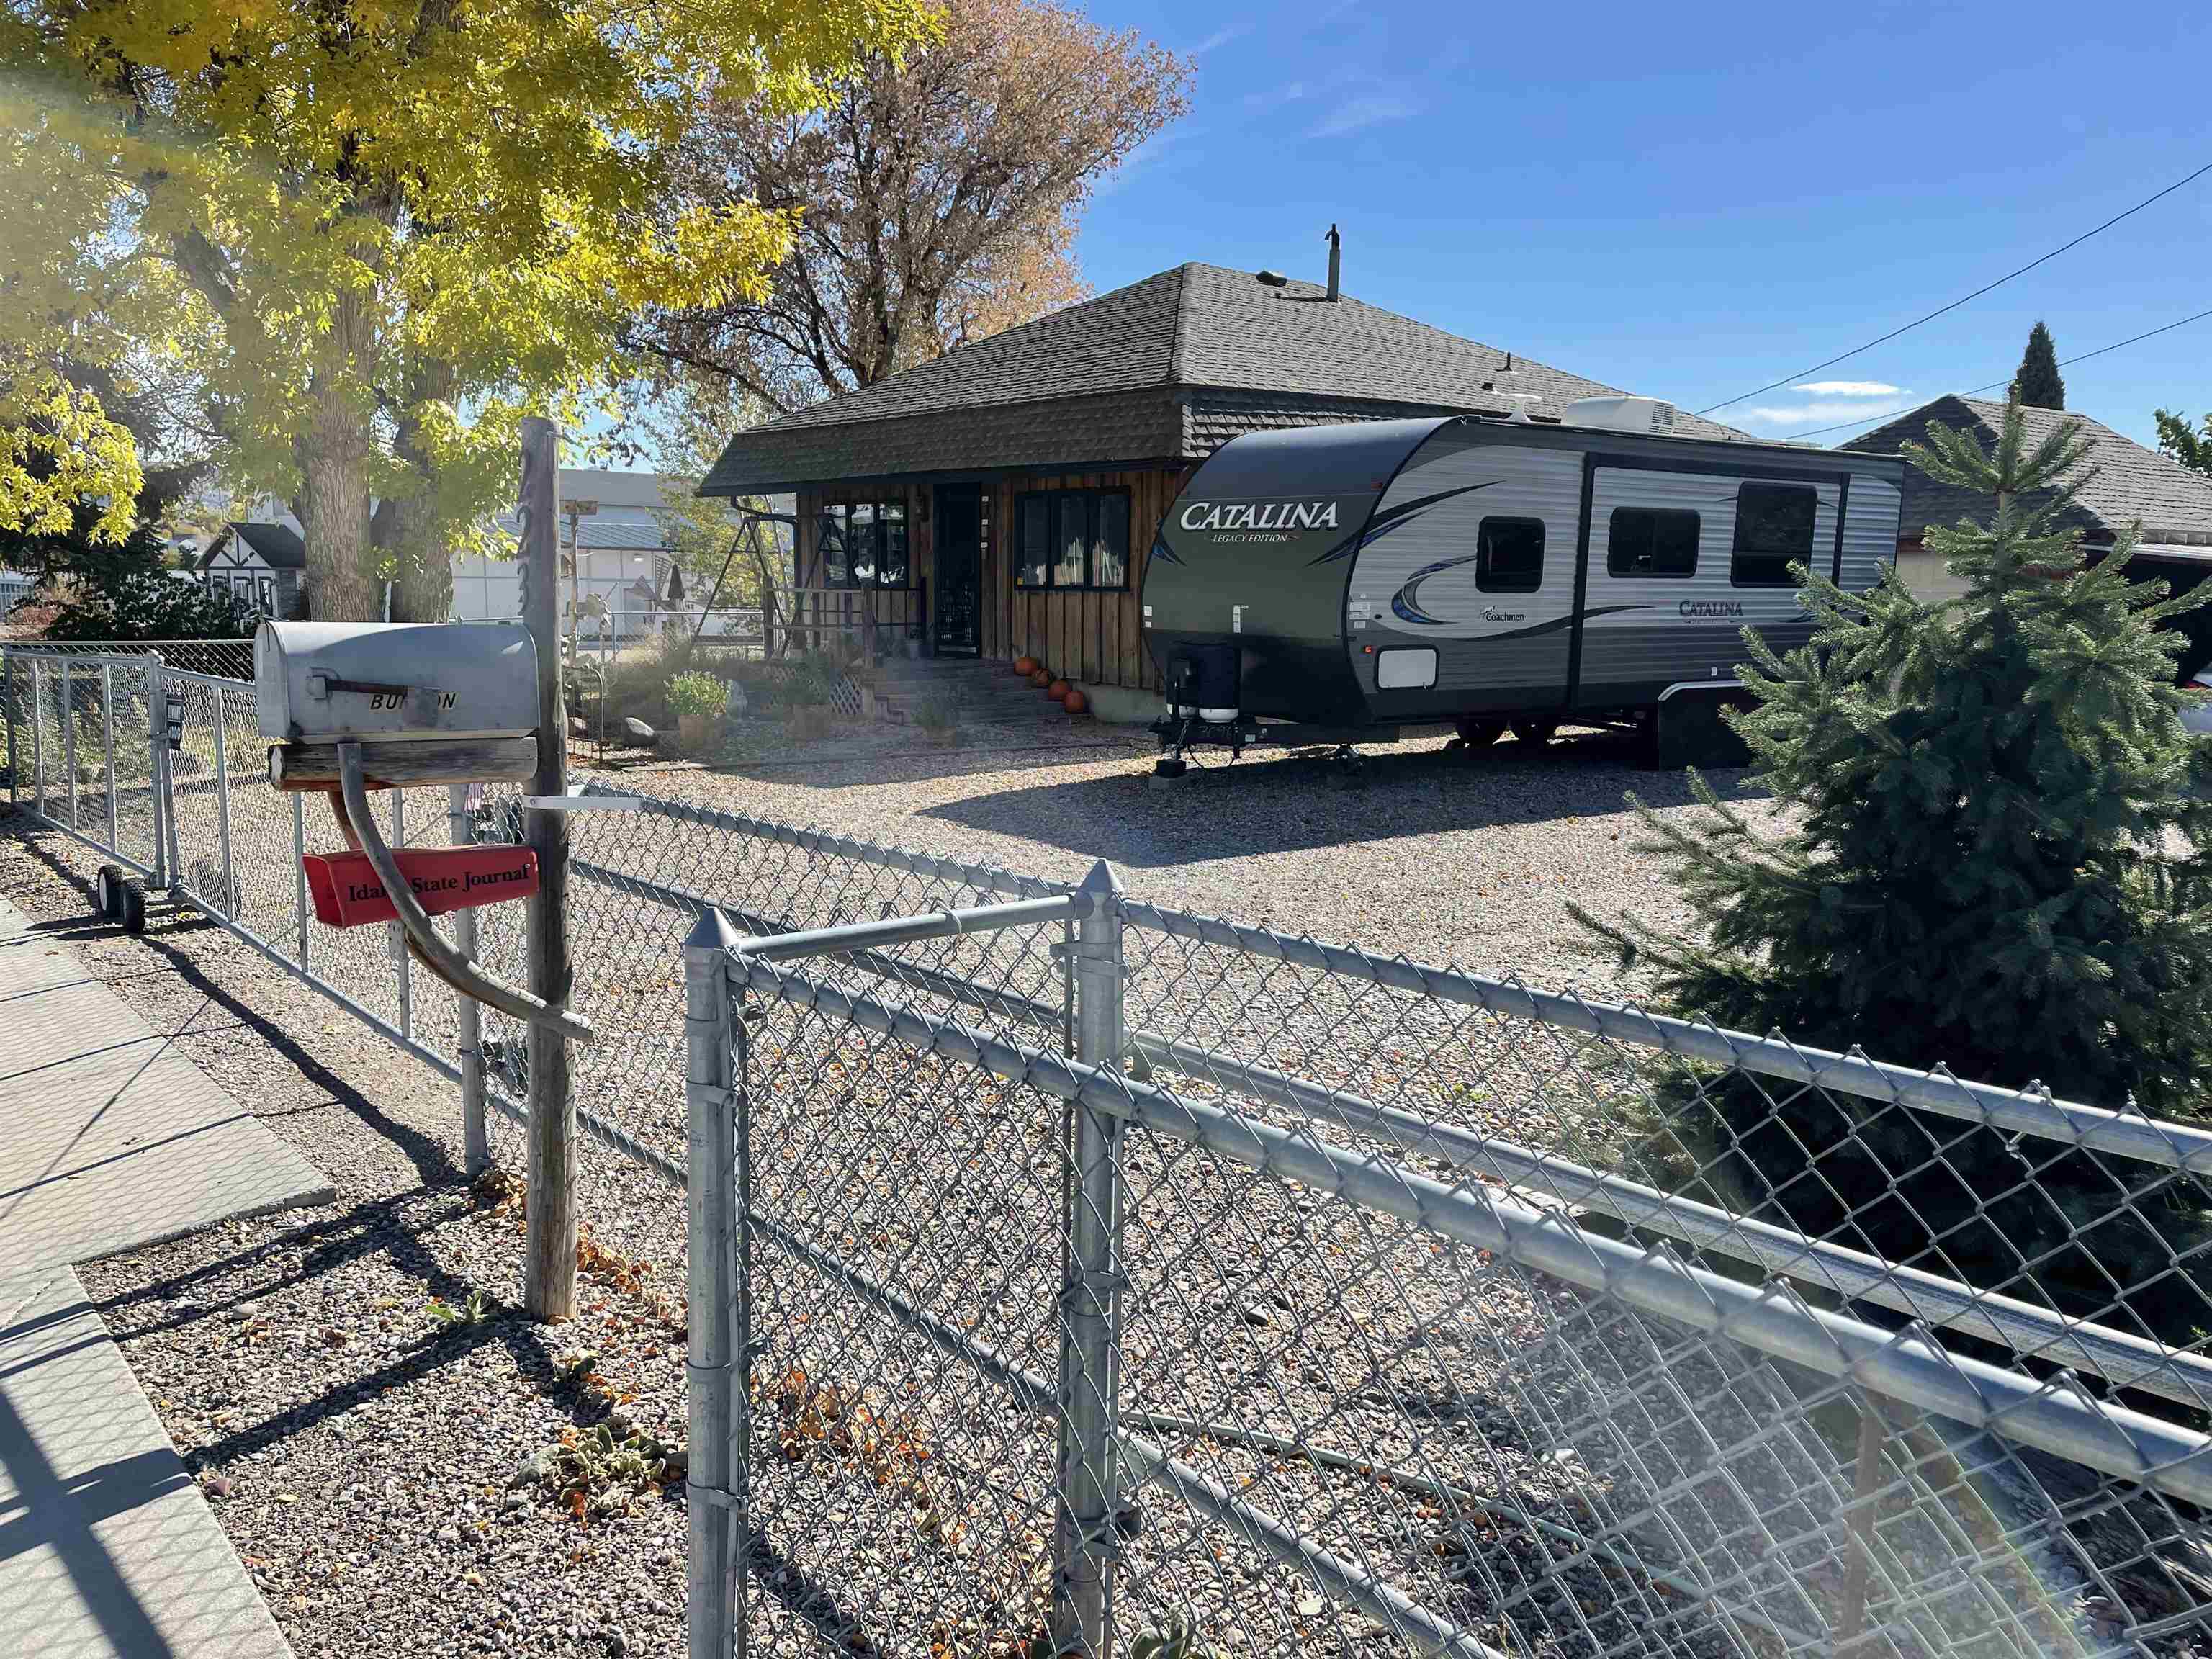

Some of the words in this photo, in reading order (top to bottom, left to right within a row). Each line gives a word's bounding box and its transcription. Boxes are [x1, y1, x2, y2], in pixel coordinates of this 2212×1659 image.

[1180, 500, 1339, 530] CATALINA
[1485, 611, 1526, 621] Coachmen
[1679, 600, 1743, 617] CATALINA
[410, 877, 458, 894] State
[462, 864, 529, 891] Journal
